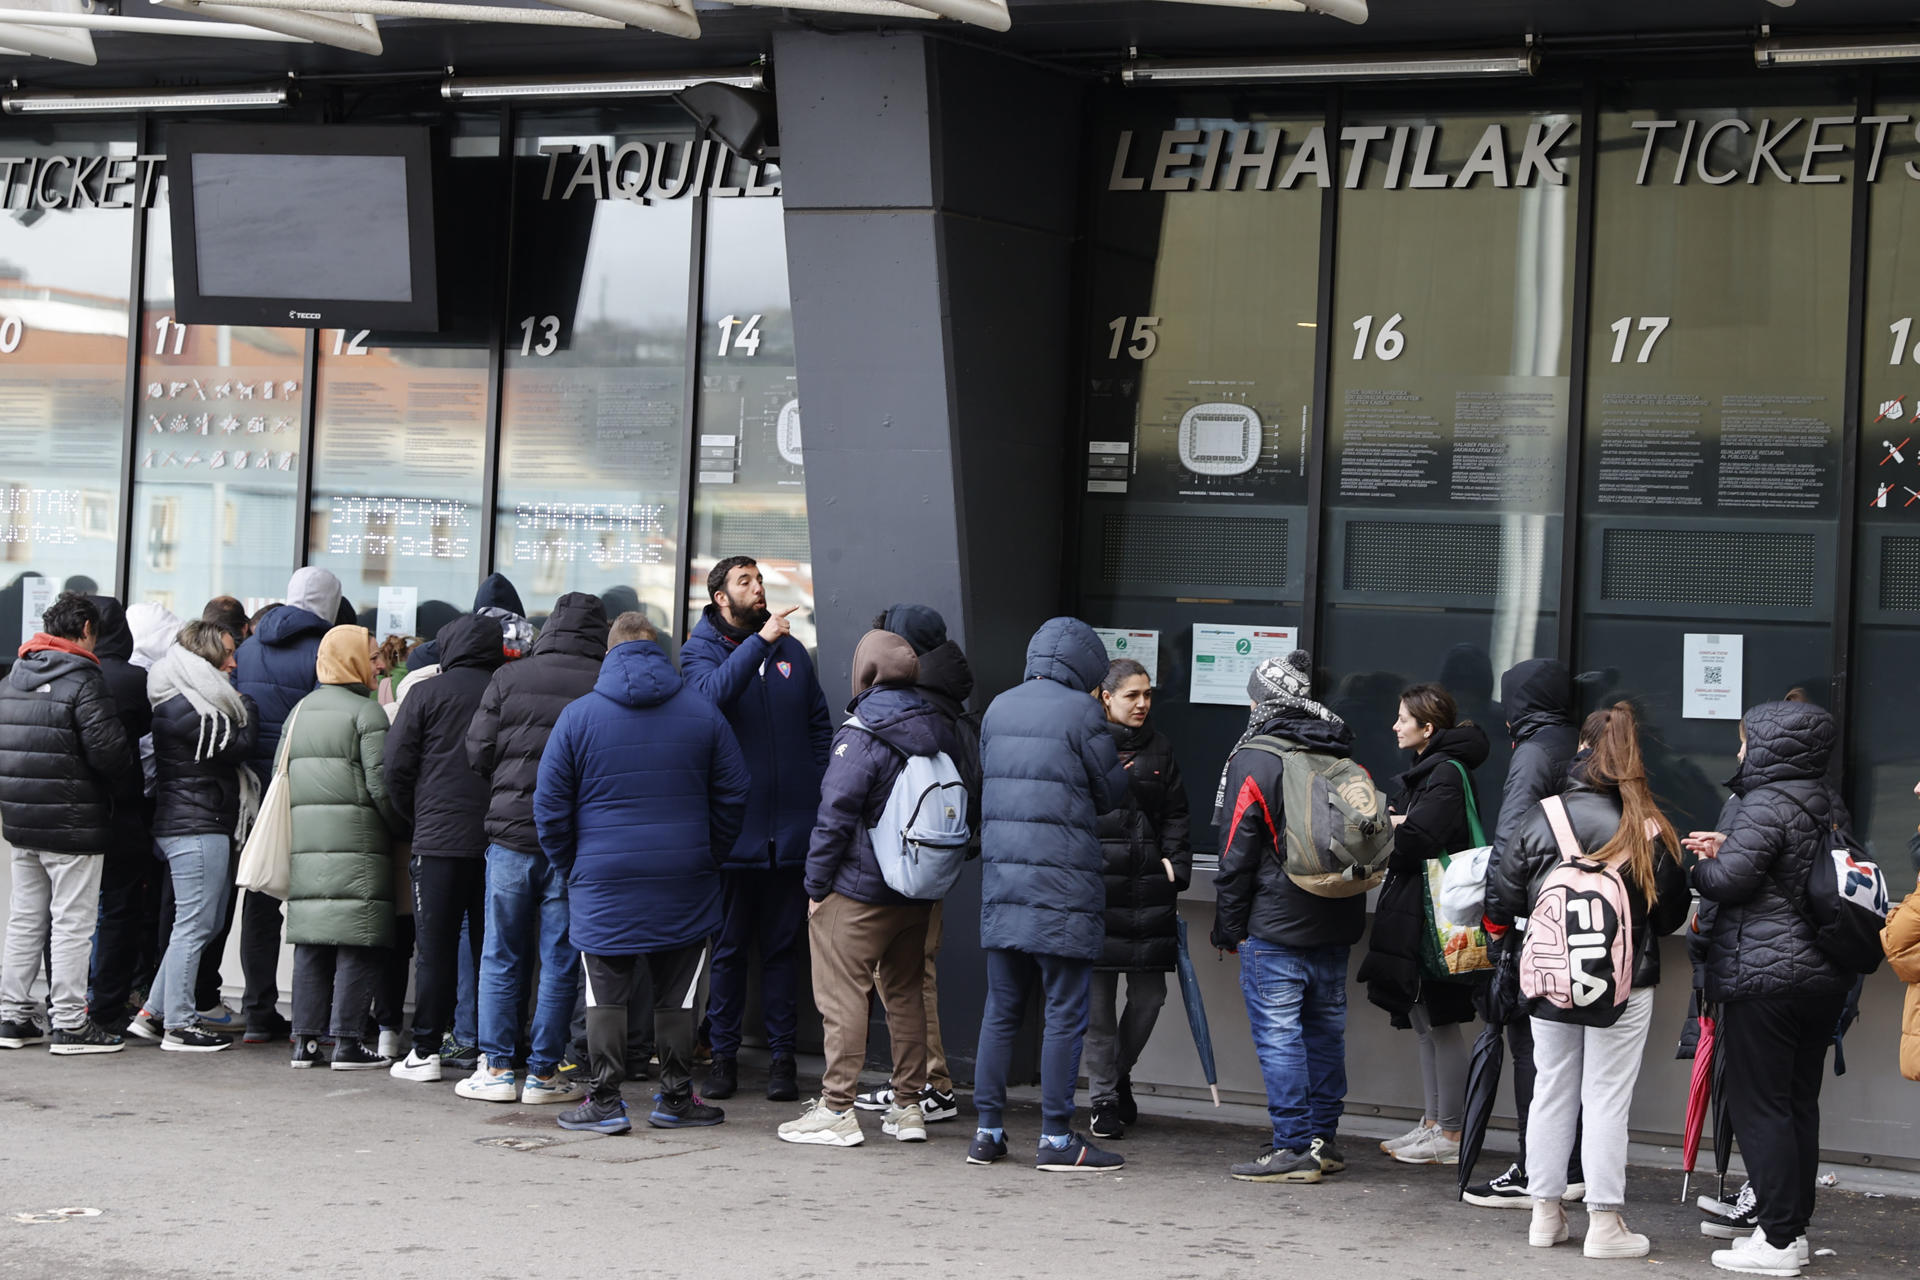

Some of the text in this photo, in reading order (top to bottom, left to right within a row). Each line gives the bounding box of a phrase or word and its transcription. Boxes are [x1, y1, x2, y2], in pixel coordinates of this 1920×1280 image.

[1108, 121, 1575, 191] LEIHATILAK
[0, 154, 168, 208] TICKET
[155, 316, 187, 355] 11
[296, 312, 322, 320] TECCO
[519, 314, 561, 357] 13
[717, 313, 763, 357] 14
[1352, 312, 1406, 361] 16
[332, 328, 371, 356] 12
[1107, 315, 1161, 360] 15
[1609, 316, 1671, 364] 17
[515, 501, 665, 533] SARRERAK
[328, 532, 470, 557] entradas
[513, 537, 663, 564] entradas
[1118, 638, 1125, 649] 2
[1239, 640, 1248, 654] 2
[1566, 897, 1609, 1008] FILA
